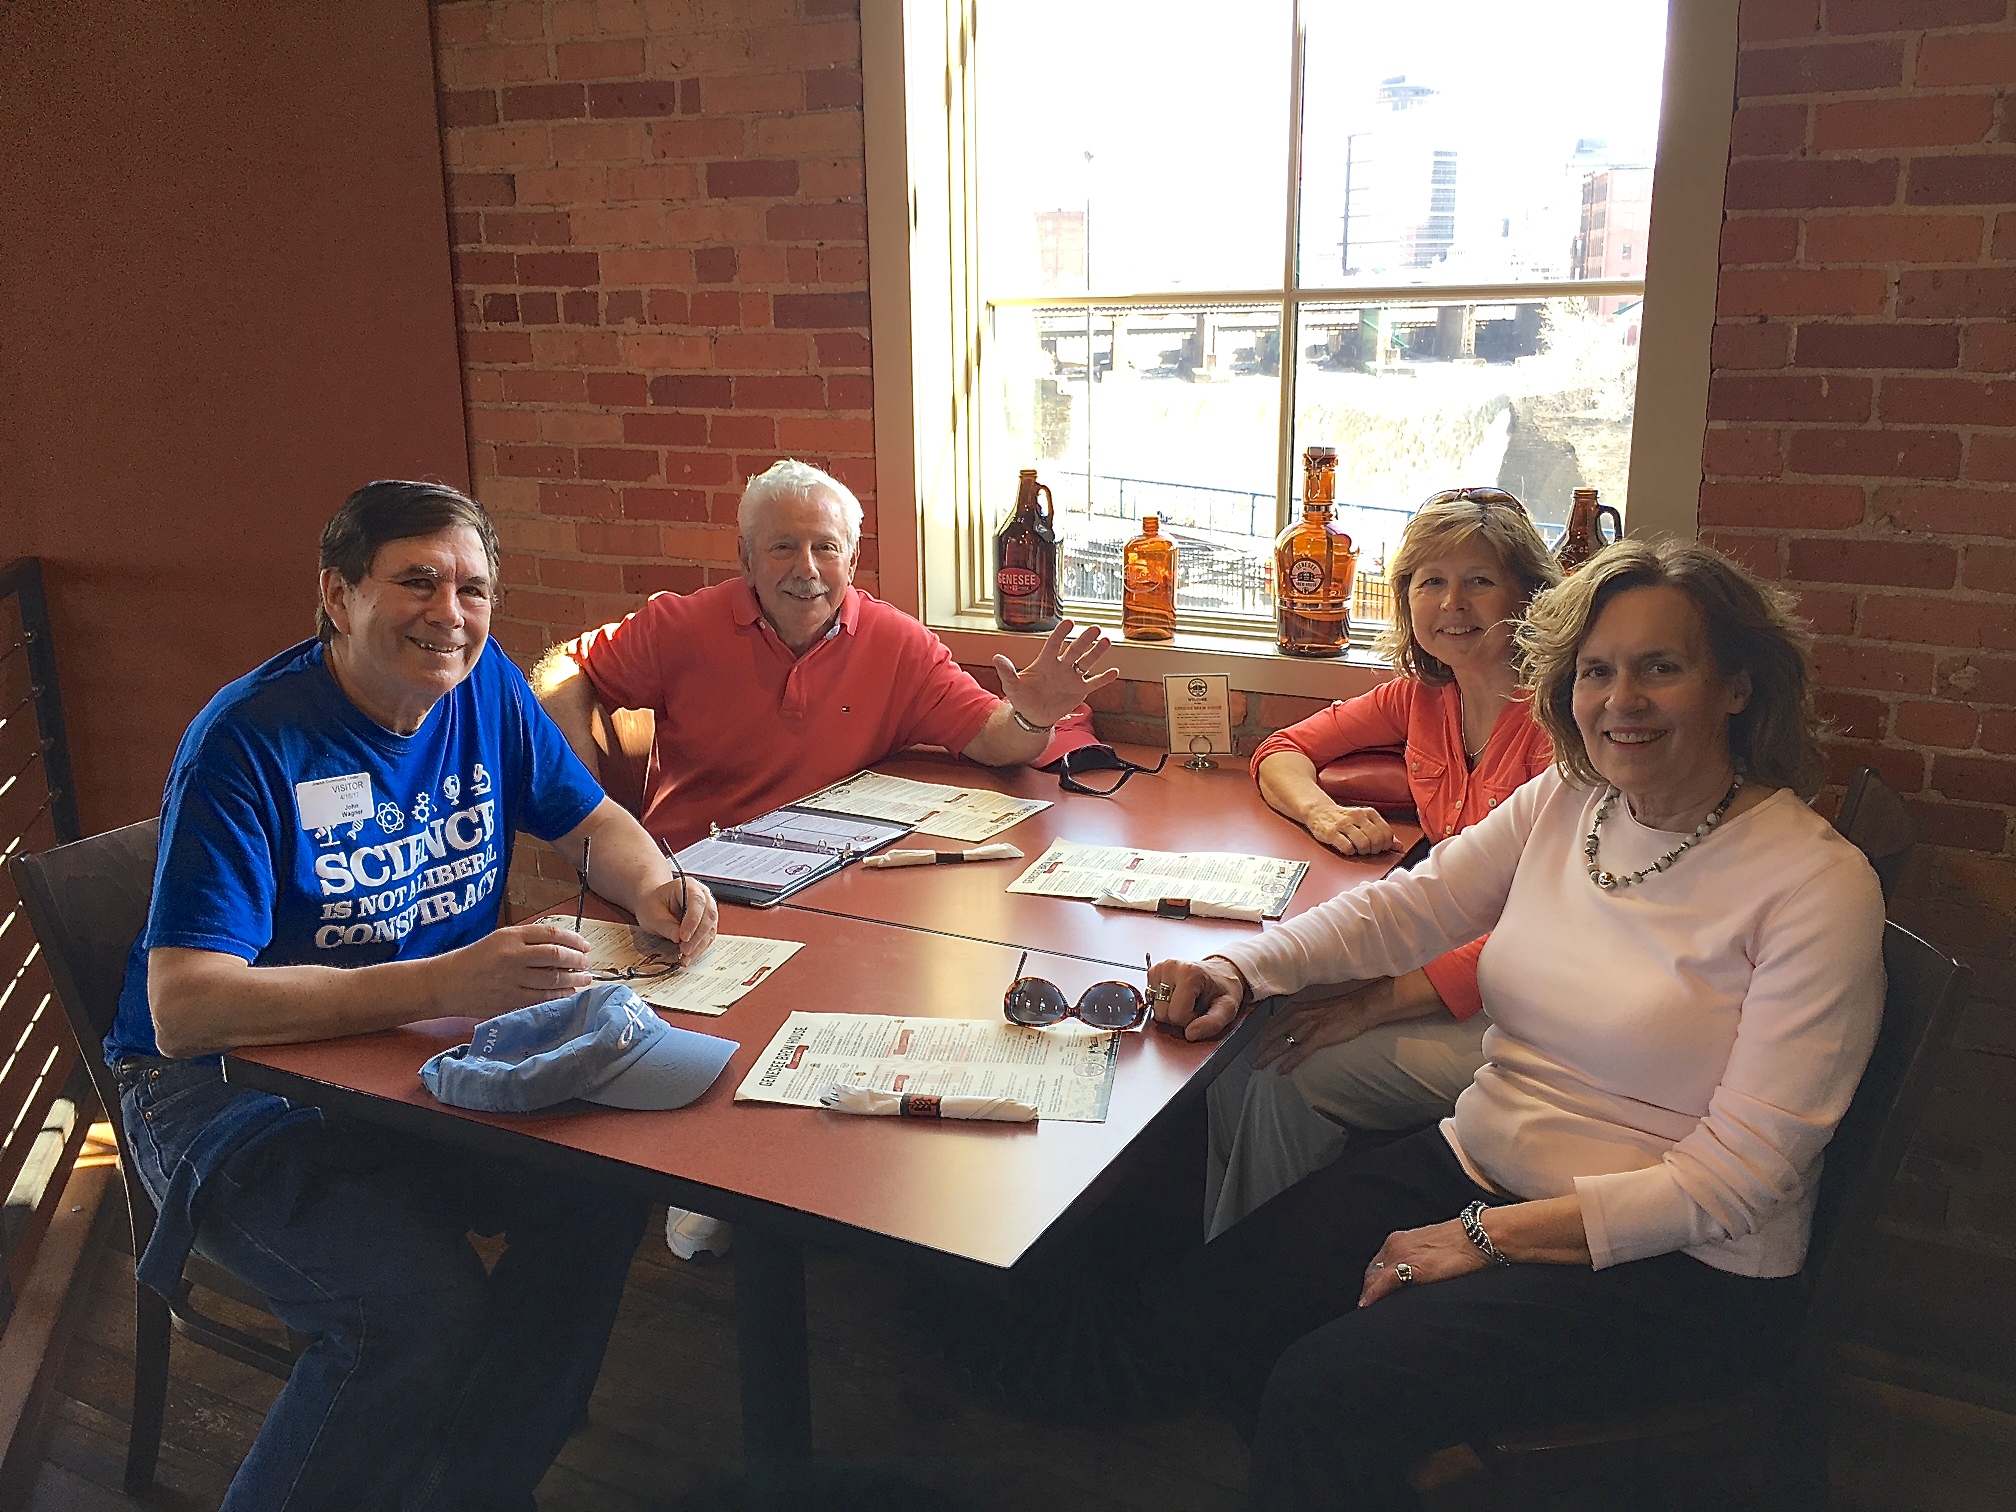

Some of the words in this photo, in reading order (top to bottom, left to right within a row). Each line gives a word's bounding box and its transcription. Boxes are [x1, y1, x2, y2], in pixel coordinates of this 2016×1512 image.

[997, 572, 1036, 585] GENESEE
[331, 780, 364, 793] VISITOR
[341, 810, 363, 818] Wagner
[315, 799, 495, 896] SCIENCE
[314, 866, 498, 949] CONSPIRACY
[320, 900, 353, 920] IS
[357, 886, 408, 918] NOT
[483, 1028, 498, 1053] NYC
[785, 1027, 808, 1044] HOUSE
[775, 1045, 796, 1061] BREW
[758, 1060, 787, 1087] GENESEE
